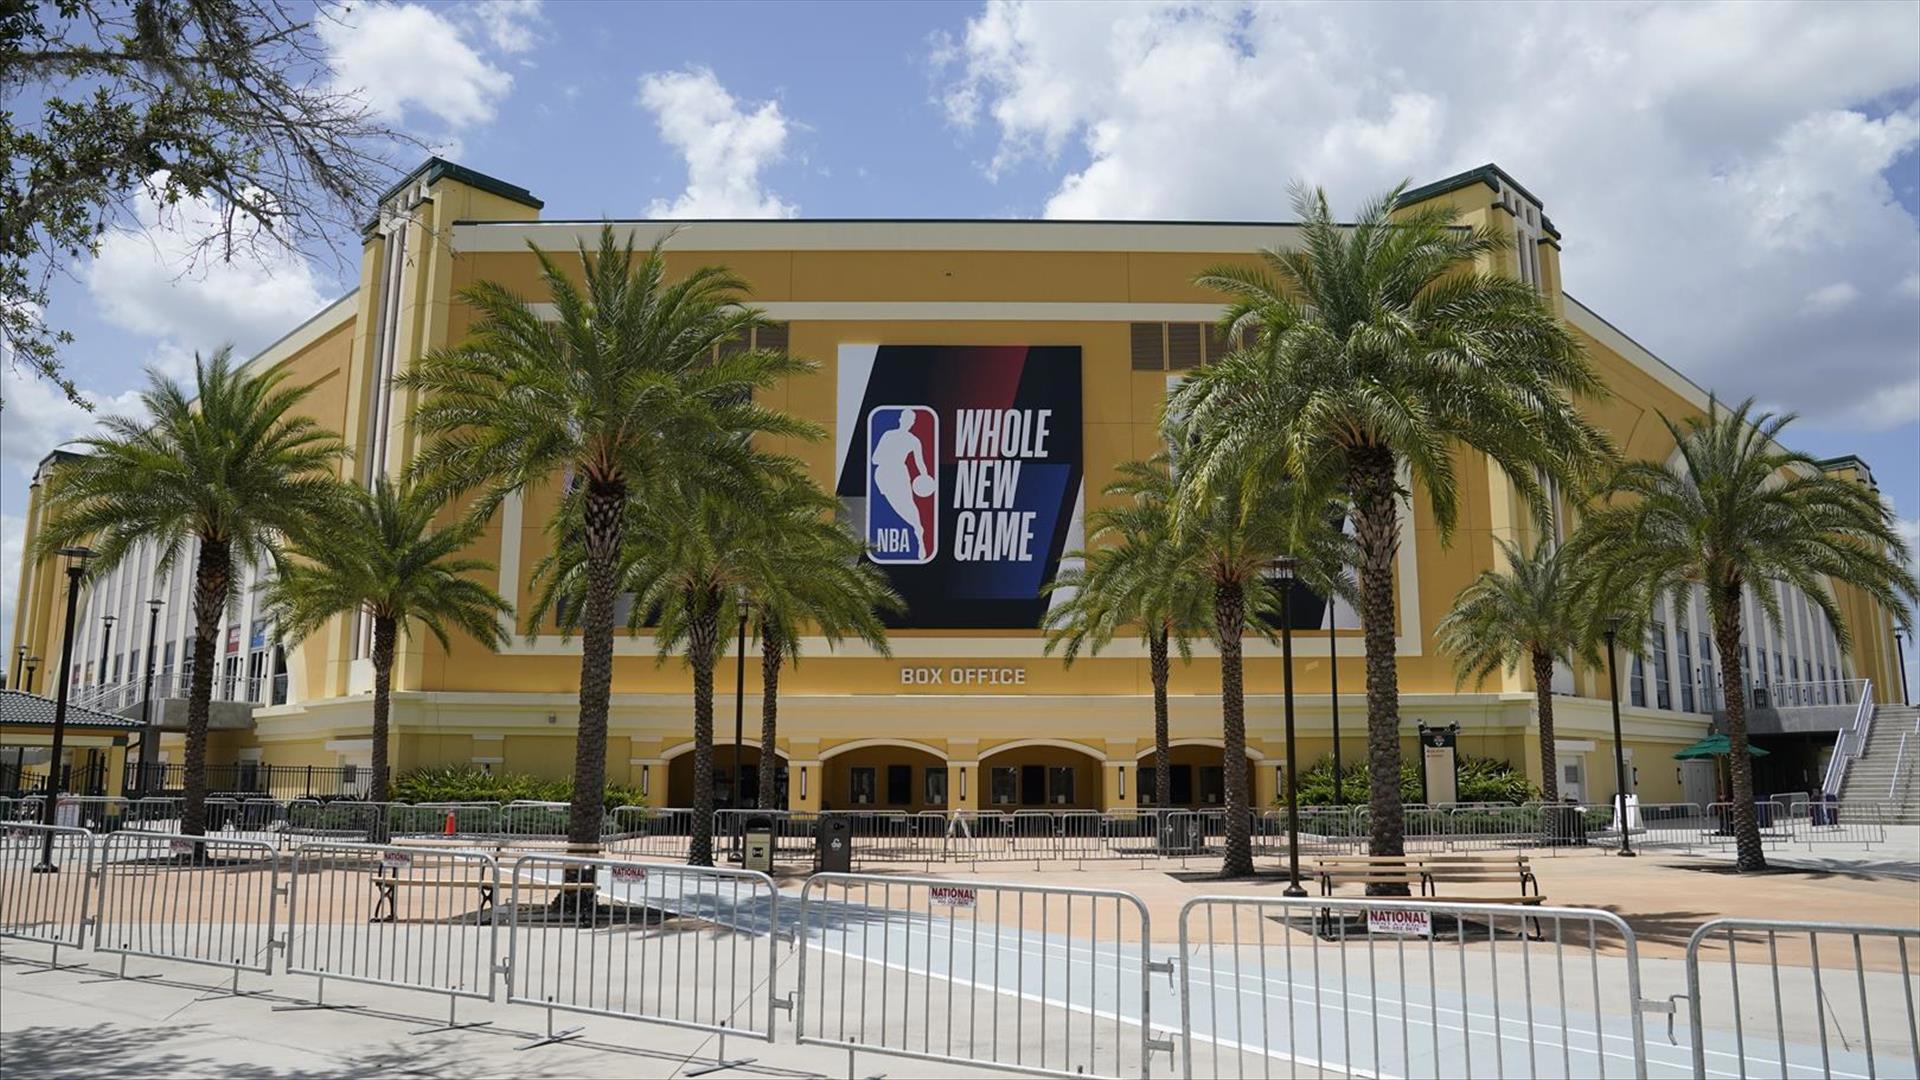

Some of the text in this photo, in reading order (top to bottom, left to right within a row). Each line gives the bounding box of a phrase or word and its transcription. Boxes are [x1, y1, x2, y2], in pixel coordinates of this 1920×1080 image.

[954, 409, 1052, 458] WHOLE
[953, 460, 1022, 508] NEW
[876, 527, 910, 553] NBA
[953, 511, 1037, 562] GAME
[900, 668, 1026, 686] BOX OFFICE
[612, 866, 645, 878] NATIONAL
[931, 887, 975, 899] NATIONAL
[1370, 910, 1428, 924] NATIONAL
